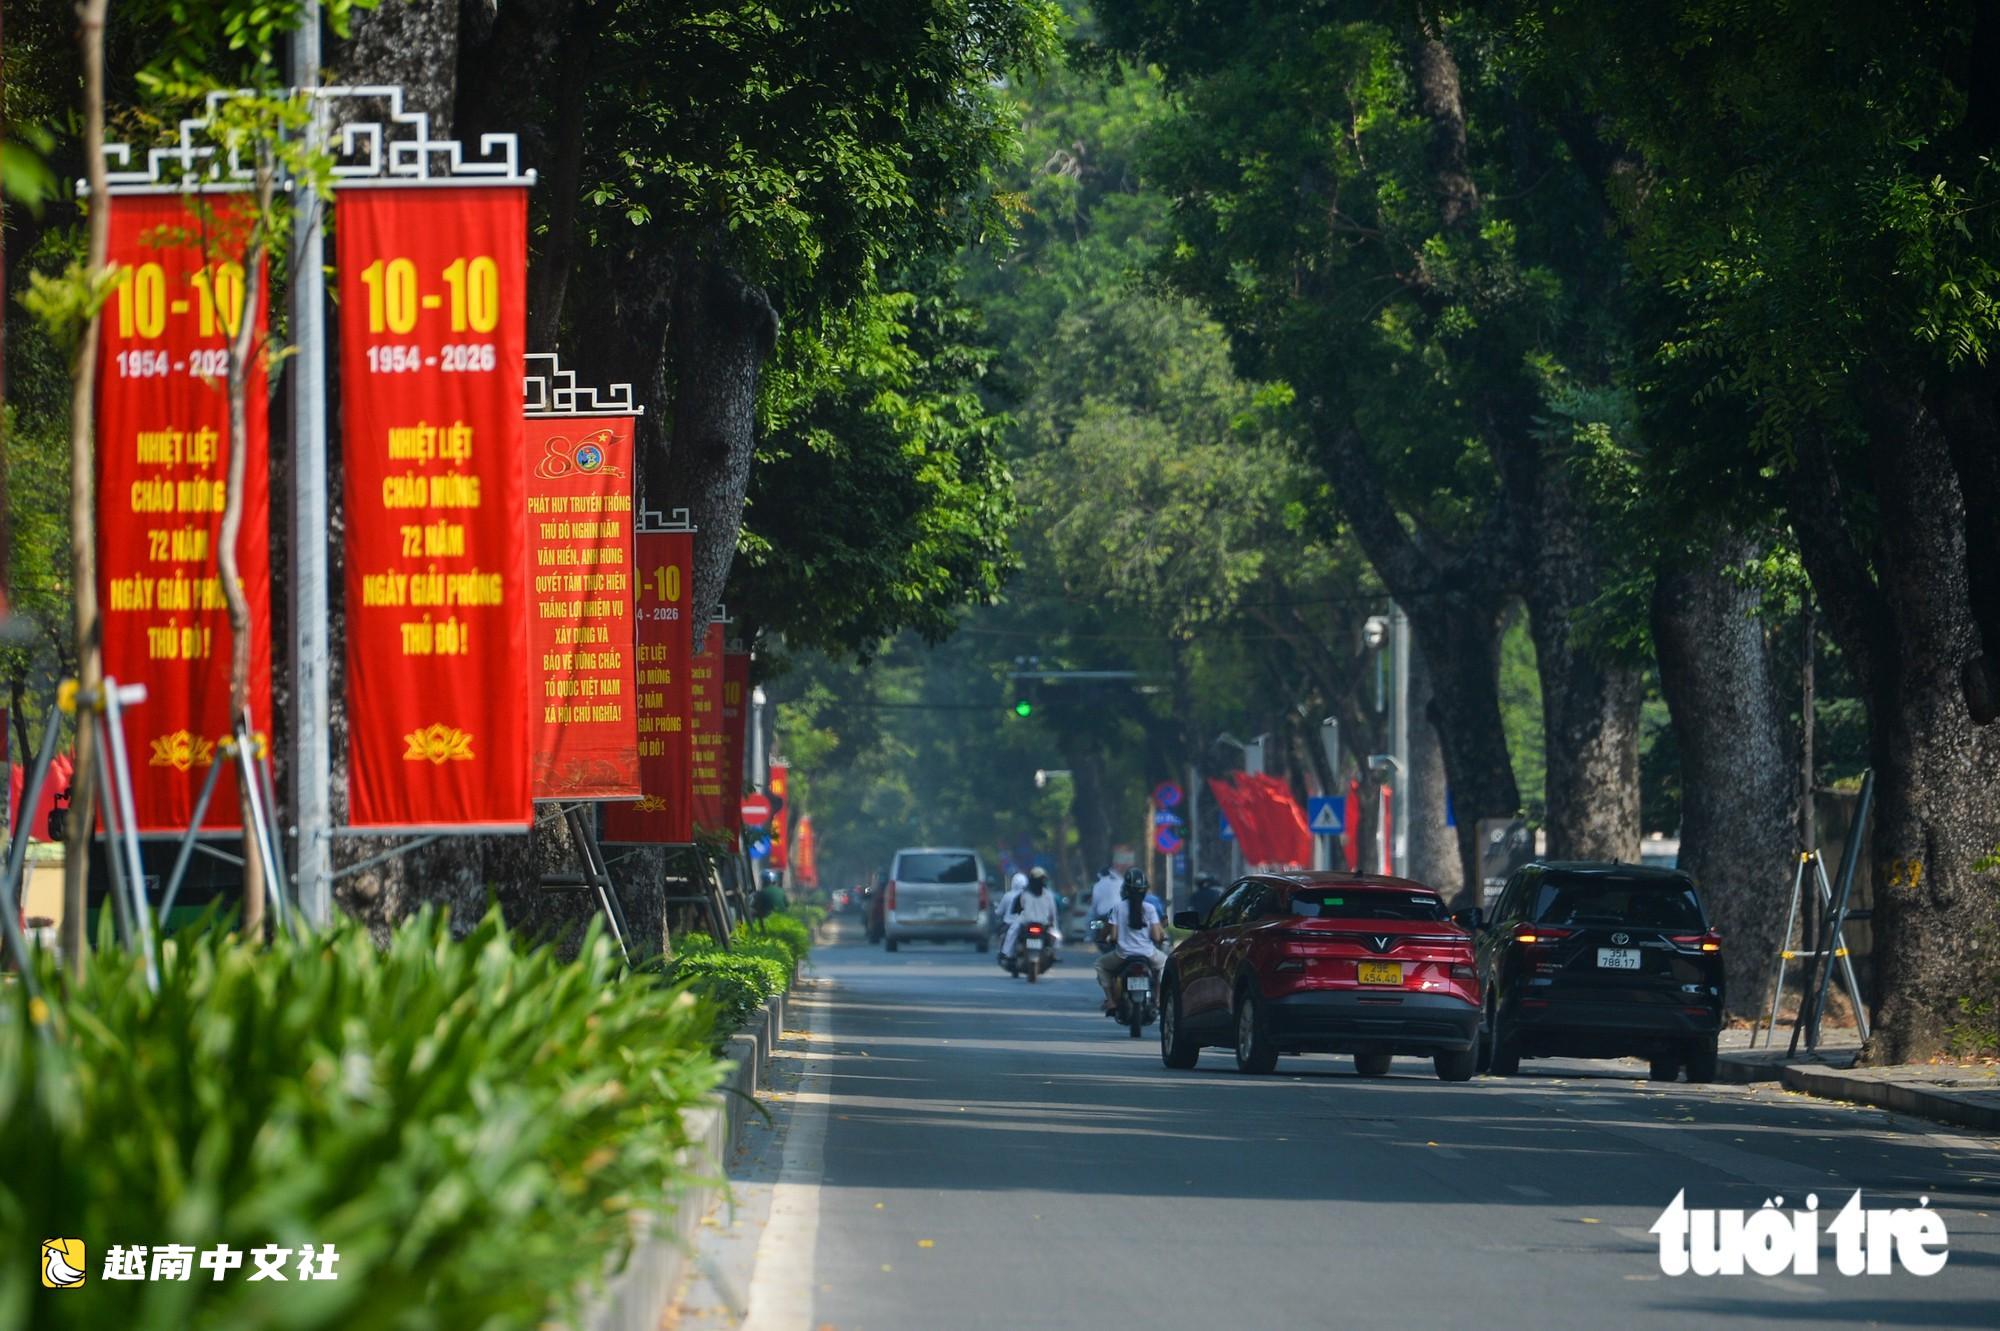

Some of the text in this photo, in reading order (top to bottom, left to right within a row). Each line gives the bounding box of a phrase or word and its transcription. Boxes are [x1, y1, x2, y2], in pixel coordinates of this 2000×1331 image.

[111, 263, 245, 339] 10-10
[361, 256, 499, 334] 10-10
[116, 351, 168, 377] 1954
[189, 349, 230, 376] 202
[366, 345, 420, 373] 1954
[440, 344, 496, 372] 2026
[137, 425, 218, 470] NHIỆT LIỆT
[388, 420, 472, 466] NHIỆT LIỆT
[382, 470, 480, 508] CHÀO MỪNG
[528, 490, 631, 513] PHÁT HUY TRUYỀN THỐNG
[400, 519, 464, 558] 72 NĂM
[540, 518, 620, 539] THỦ ĐÔ NGHÌN NĂM
[148, 524, 208, 562] 72 NĂM
[538, 544, 622, 567] VĂN HIẾN, ANH HÙNG
[110, 572, 154, 611] NGÀY
[157, 568, 190, 611] GIẢI
[363, 564, 503, 606] NGÀY GIẢI PHÓNG
[536, 571, 626, 594] QUYẾT TÂM THỰC HIỆN
[636, 565, 680, 602] -10
[539, 596, 566, 618] THẮNG
[569, 600, 582, 621] LỢI
[584, 597, 610, 620] NHIỆM
[612, 600, 623, 620] VỤ
[654, 608, 678, 620] 2026
[148, 618, 178, 659] THỦ
[400, 613, 434, 656] THỦ
[436, 616, 458, 656] ĐÔ
[555, 624, 608, 647] XÂY DỰNG VÀ
[544, 646, 621, 674] BẢO VỆ VỮNG CHẮC
[638, 643, 666, 664] IỆT LIỆT
[545, 674, 620, 699] TỔ QUỐC VIỆT NAM
[648, 666, 670, 684] MỪNG
[638, 691, 663, 709] 2 NĂM
[544, 701, 622, 726] XÃ HỘI CHỦ NGHĨA!
[656, 714, 682, 732] PHÓNG
[650, 738, 660, 756] ĐÔ
[1610, 950, 1627, 958] 35A
